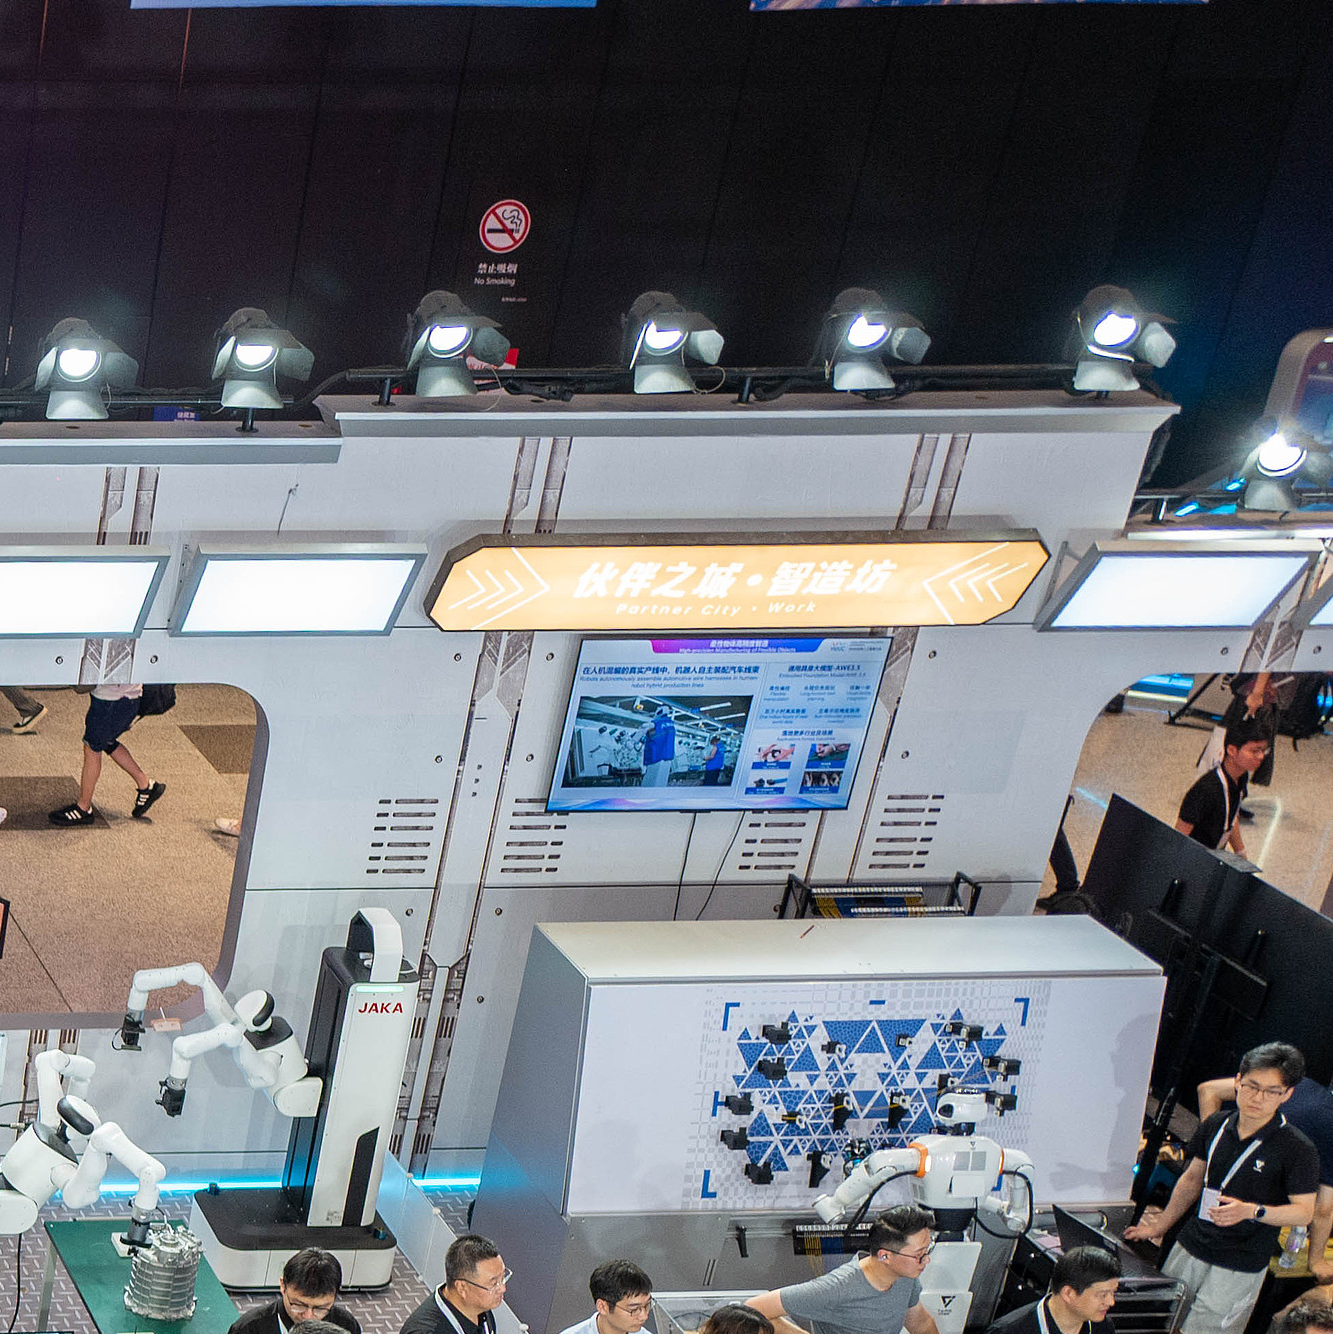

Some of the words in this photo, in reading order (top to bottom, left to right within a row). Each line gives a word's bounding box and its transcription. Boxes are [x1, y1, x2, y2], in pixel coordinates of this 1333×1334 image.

[477, 263, 519, 274] 禁止吸烟
[474, 277, 485, 285] No
[485, 277, 516, 287] Smoking
[572, 559, 898, 599] 伙伴之城·智造坊
[616, 603, 693, 615] Partner
[701, 603, 741, 616] City
[768, 602, 817, 613] Work
[358, 1002, 403, 1014] JAKA
